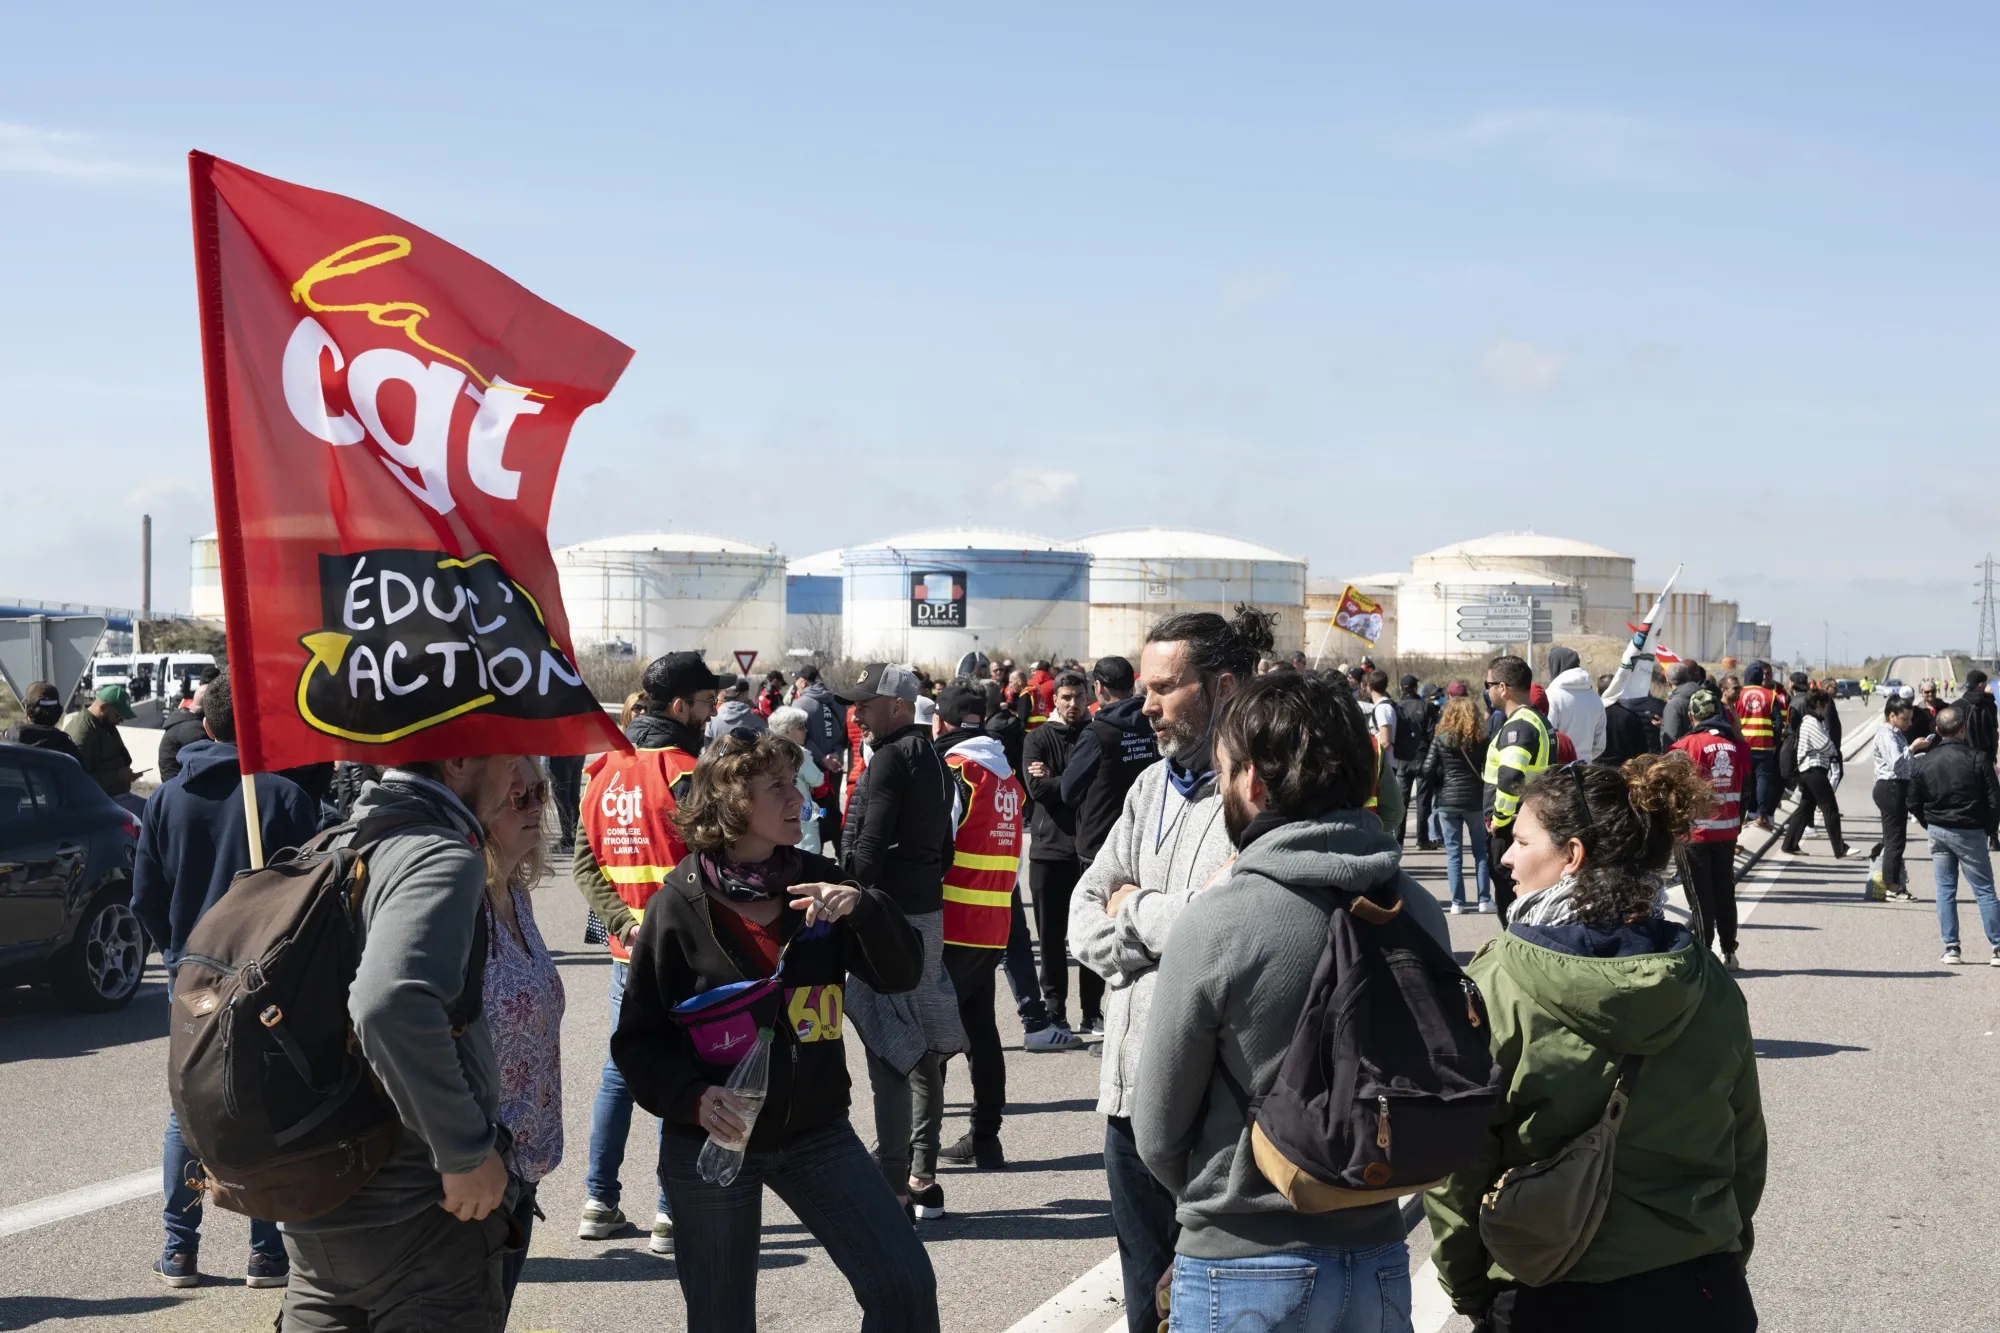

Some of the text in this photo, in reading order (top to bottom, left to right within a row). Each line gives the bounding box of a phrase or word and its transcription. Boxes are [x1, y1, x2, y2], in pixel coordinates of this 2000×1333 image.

[917, 603, 960, 618] D.P.F.
[824, 720, 833, 737] AIR
[601, 785, 643, 826] cgt
[994, 788, 1019, 821] cgt
[788, 984, 843, 1043] 60
